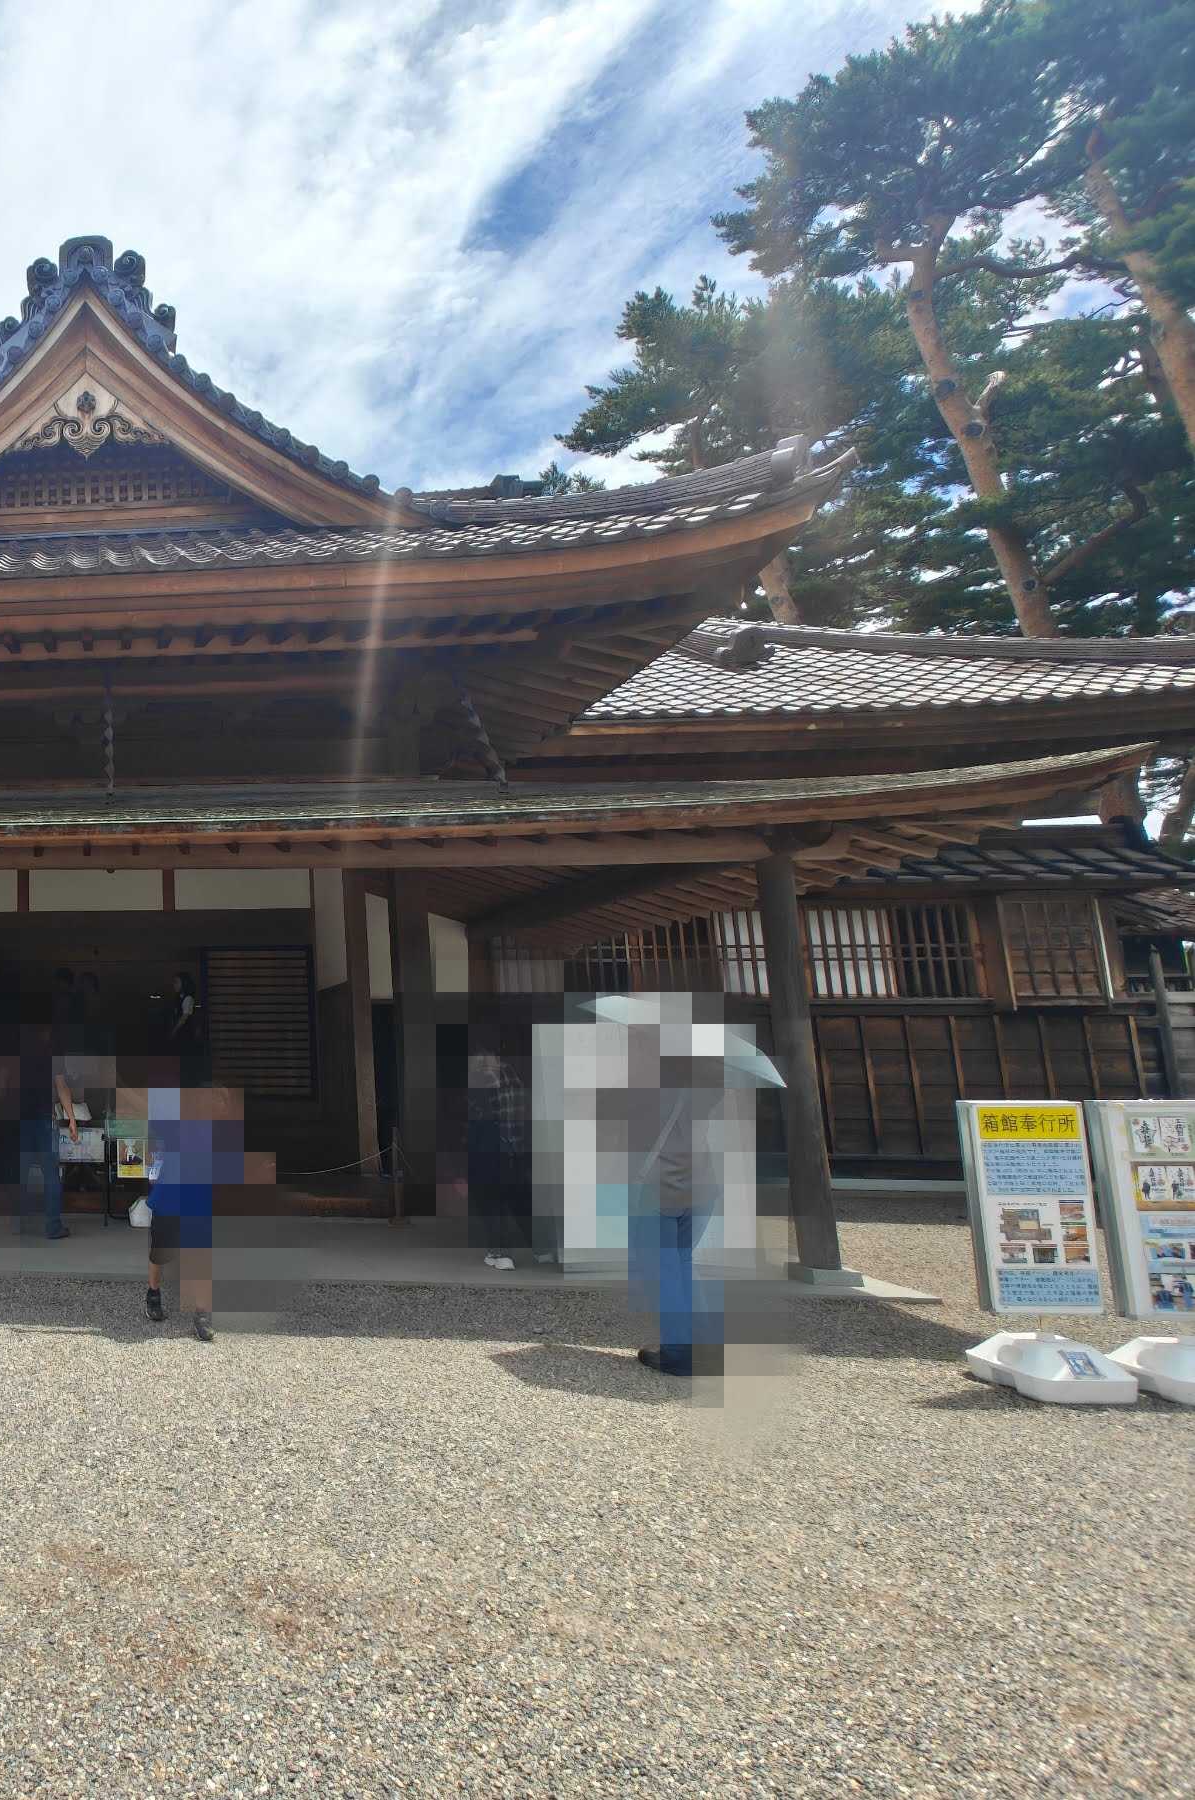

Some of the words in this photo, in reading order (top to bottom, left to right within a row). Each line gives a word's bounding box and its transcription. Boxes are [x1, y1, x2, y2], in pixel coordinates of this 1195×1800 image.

[982, 1113, 1075, 1132] 箱館奉行所
